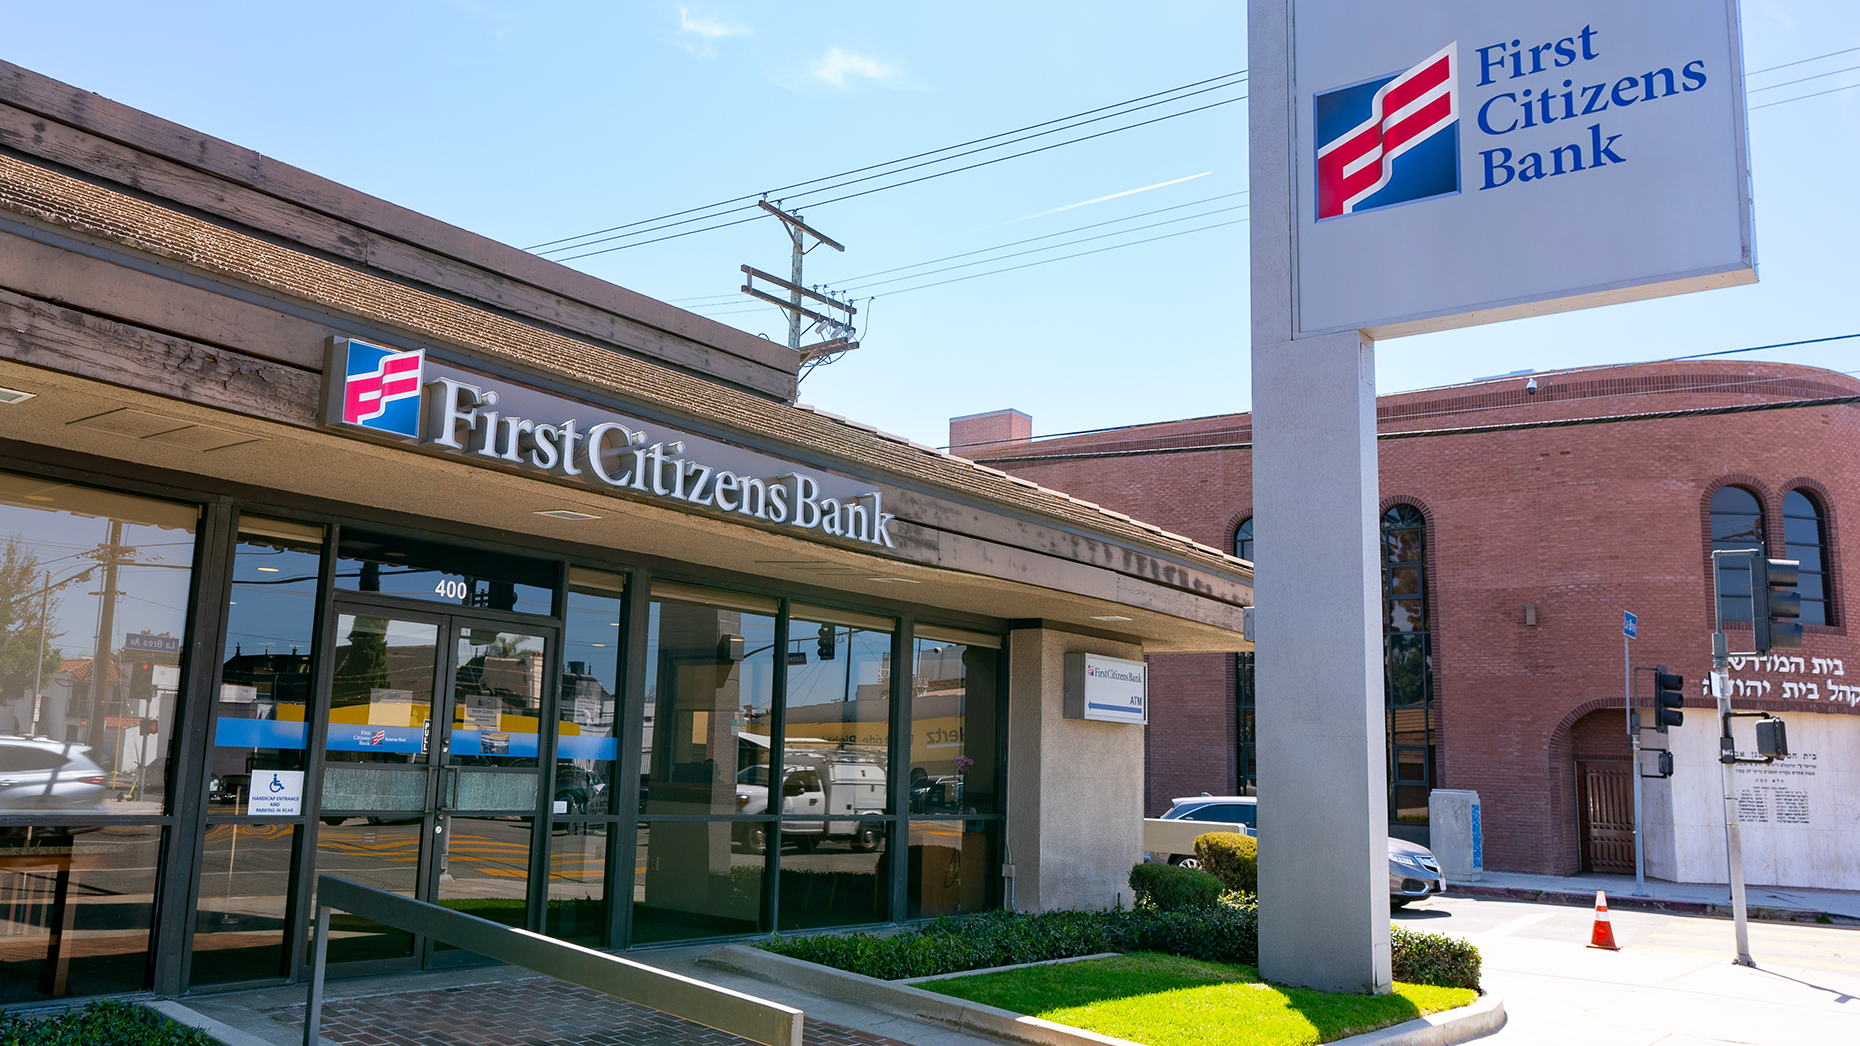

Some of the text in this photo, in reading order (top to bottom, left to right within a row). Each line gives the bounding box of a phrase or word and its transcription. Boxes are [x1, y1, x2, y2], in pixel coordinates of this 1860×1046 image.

[1474, 24, 1600, 88] First
[1476, 59, 1708, 136] Citizens
[1478, 123, 1627, 191] Bank
[433, 377, 896, 549] First Citizens Bank
[435, 579, 467, 600] 400
[1094, 667, 1142, 683] First Citizens Bank
[1727, 654, 1844, 676] בית המדרש
[1130, 696, 1142, 706] ATM
[1781, 681, 1819, 700] בית
